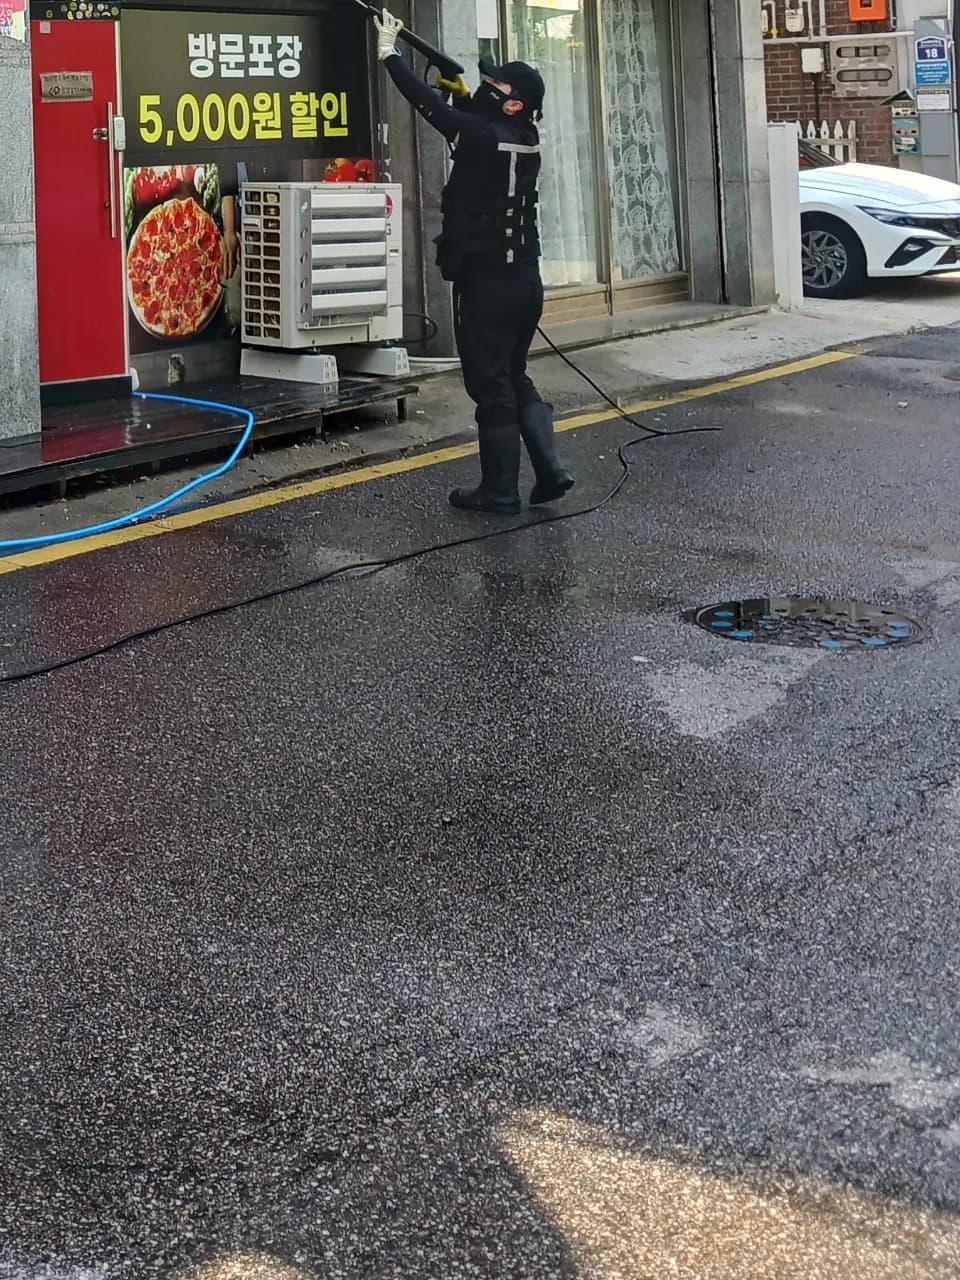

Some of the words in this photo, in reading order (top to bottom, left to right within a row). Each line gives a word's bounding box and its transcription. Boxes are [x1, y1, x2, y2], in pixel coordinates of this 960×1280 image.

[187, 32, 303, 79] 방문포장
[925, 48, 938, 58] 18
[138, 92, 283, 147] 5,000원
[289, 91, 349, 139] 할인
